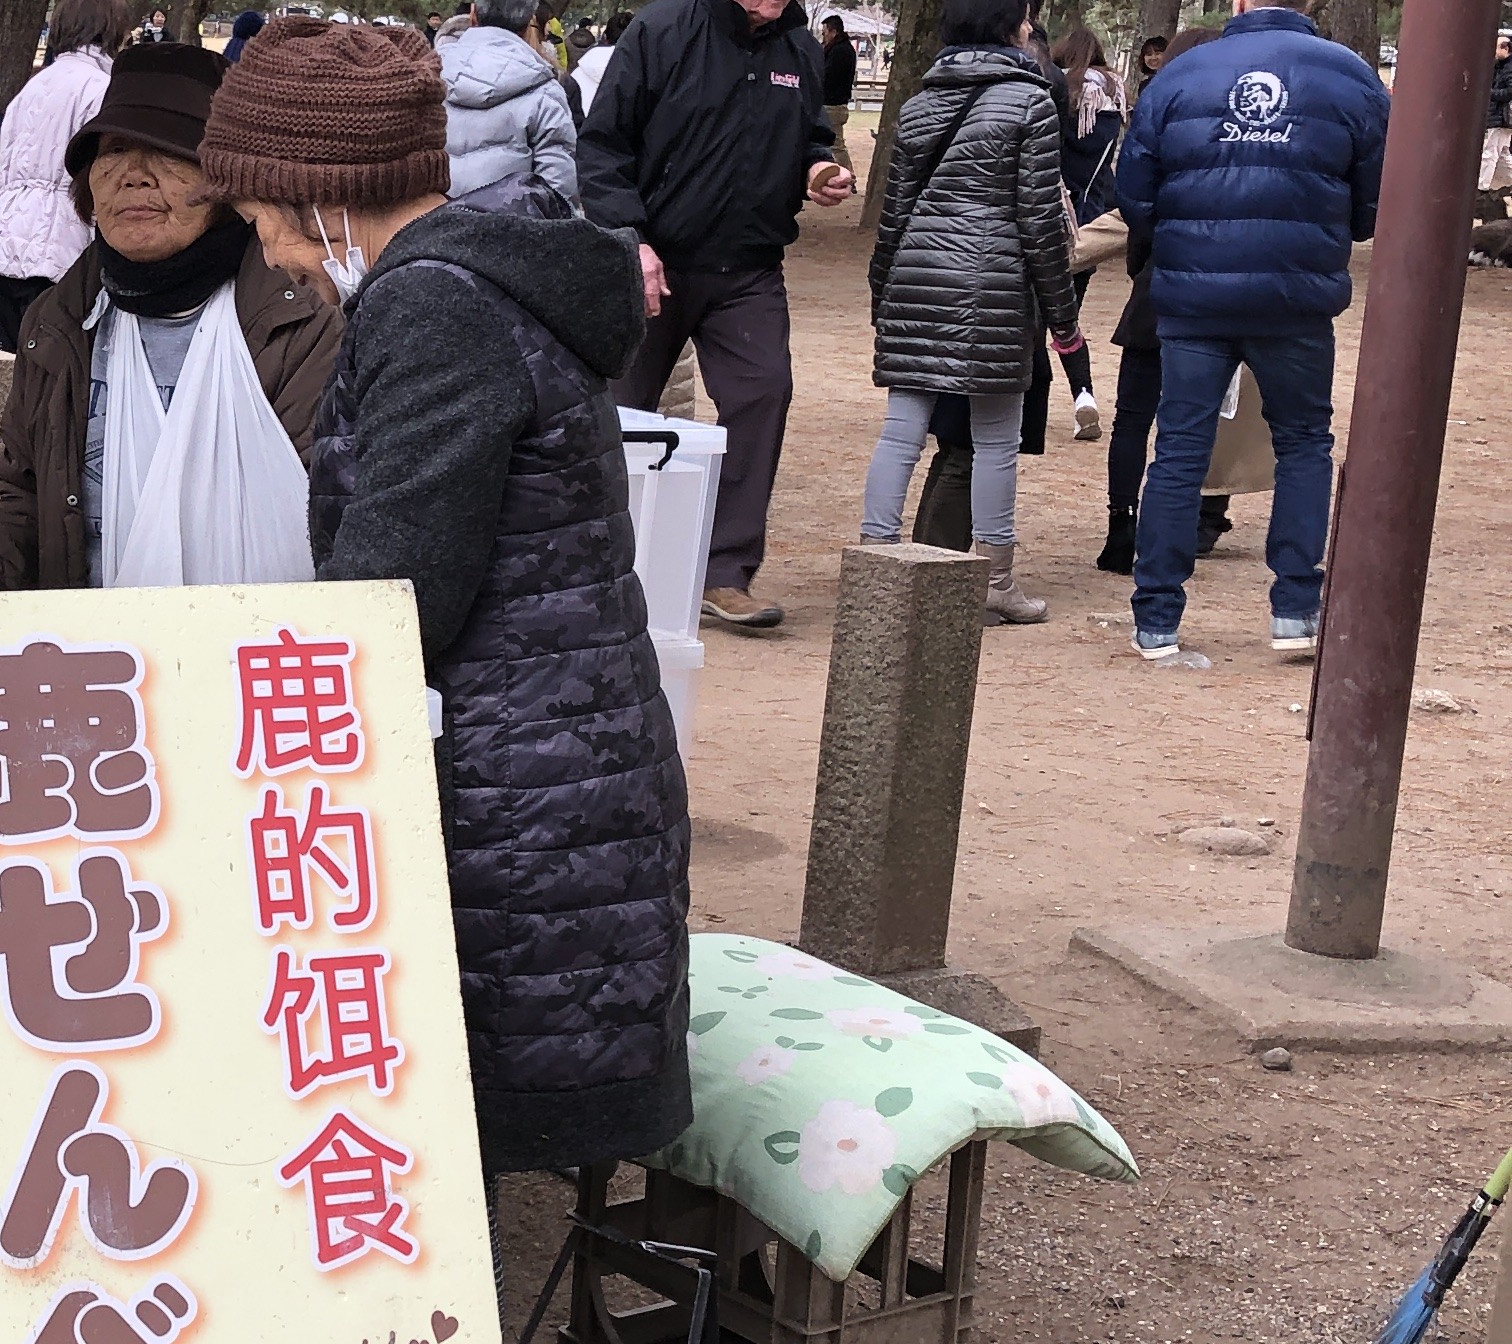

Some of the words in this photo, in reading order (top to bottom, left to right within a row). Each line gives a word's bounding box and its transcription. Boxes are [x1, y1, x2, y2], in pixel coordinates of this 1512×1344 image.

[1219, 121, 1293, 143] Diesel
[236, 629, 414, 1264] 鹿的饵食
